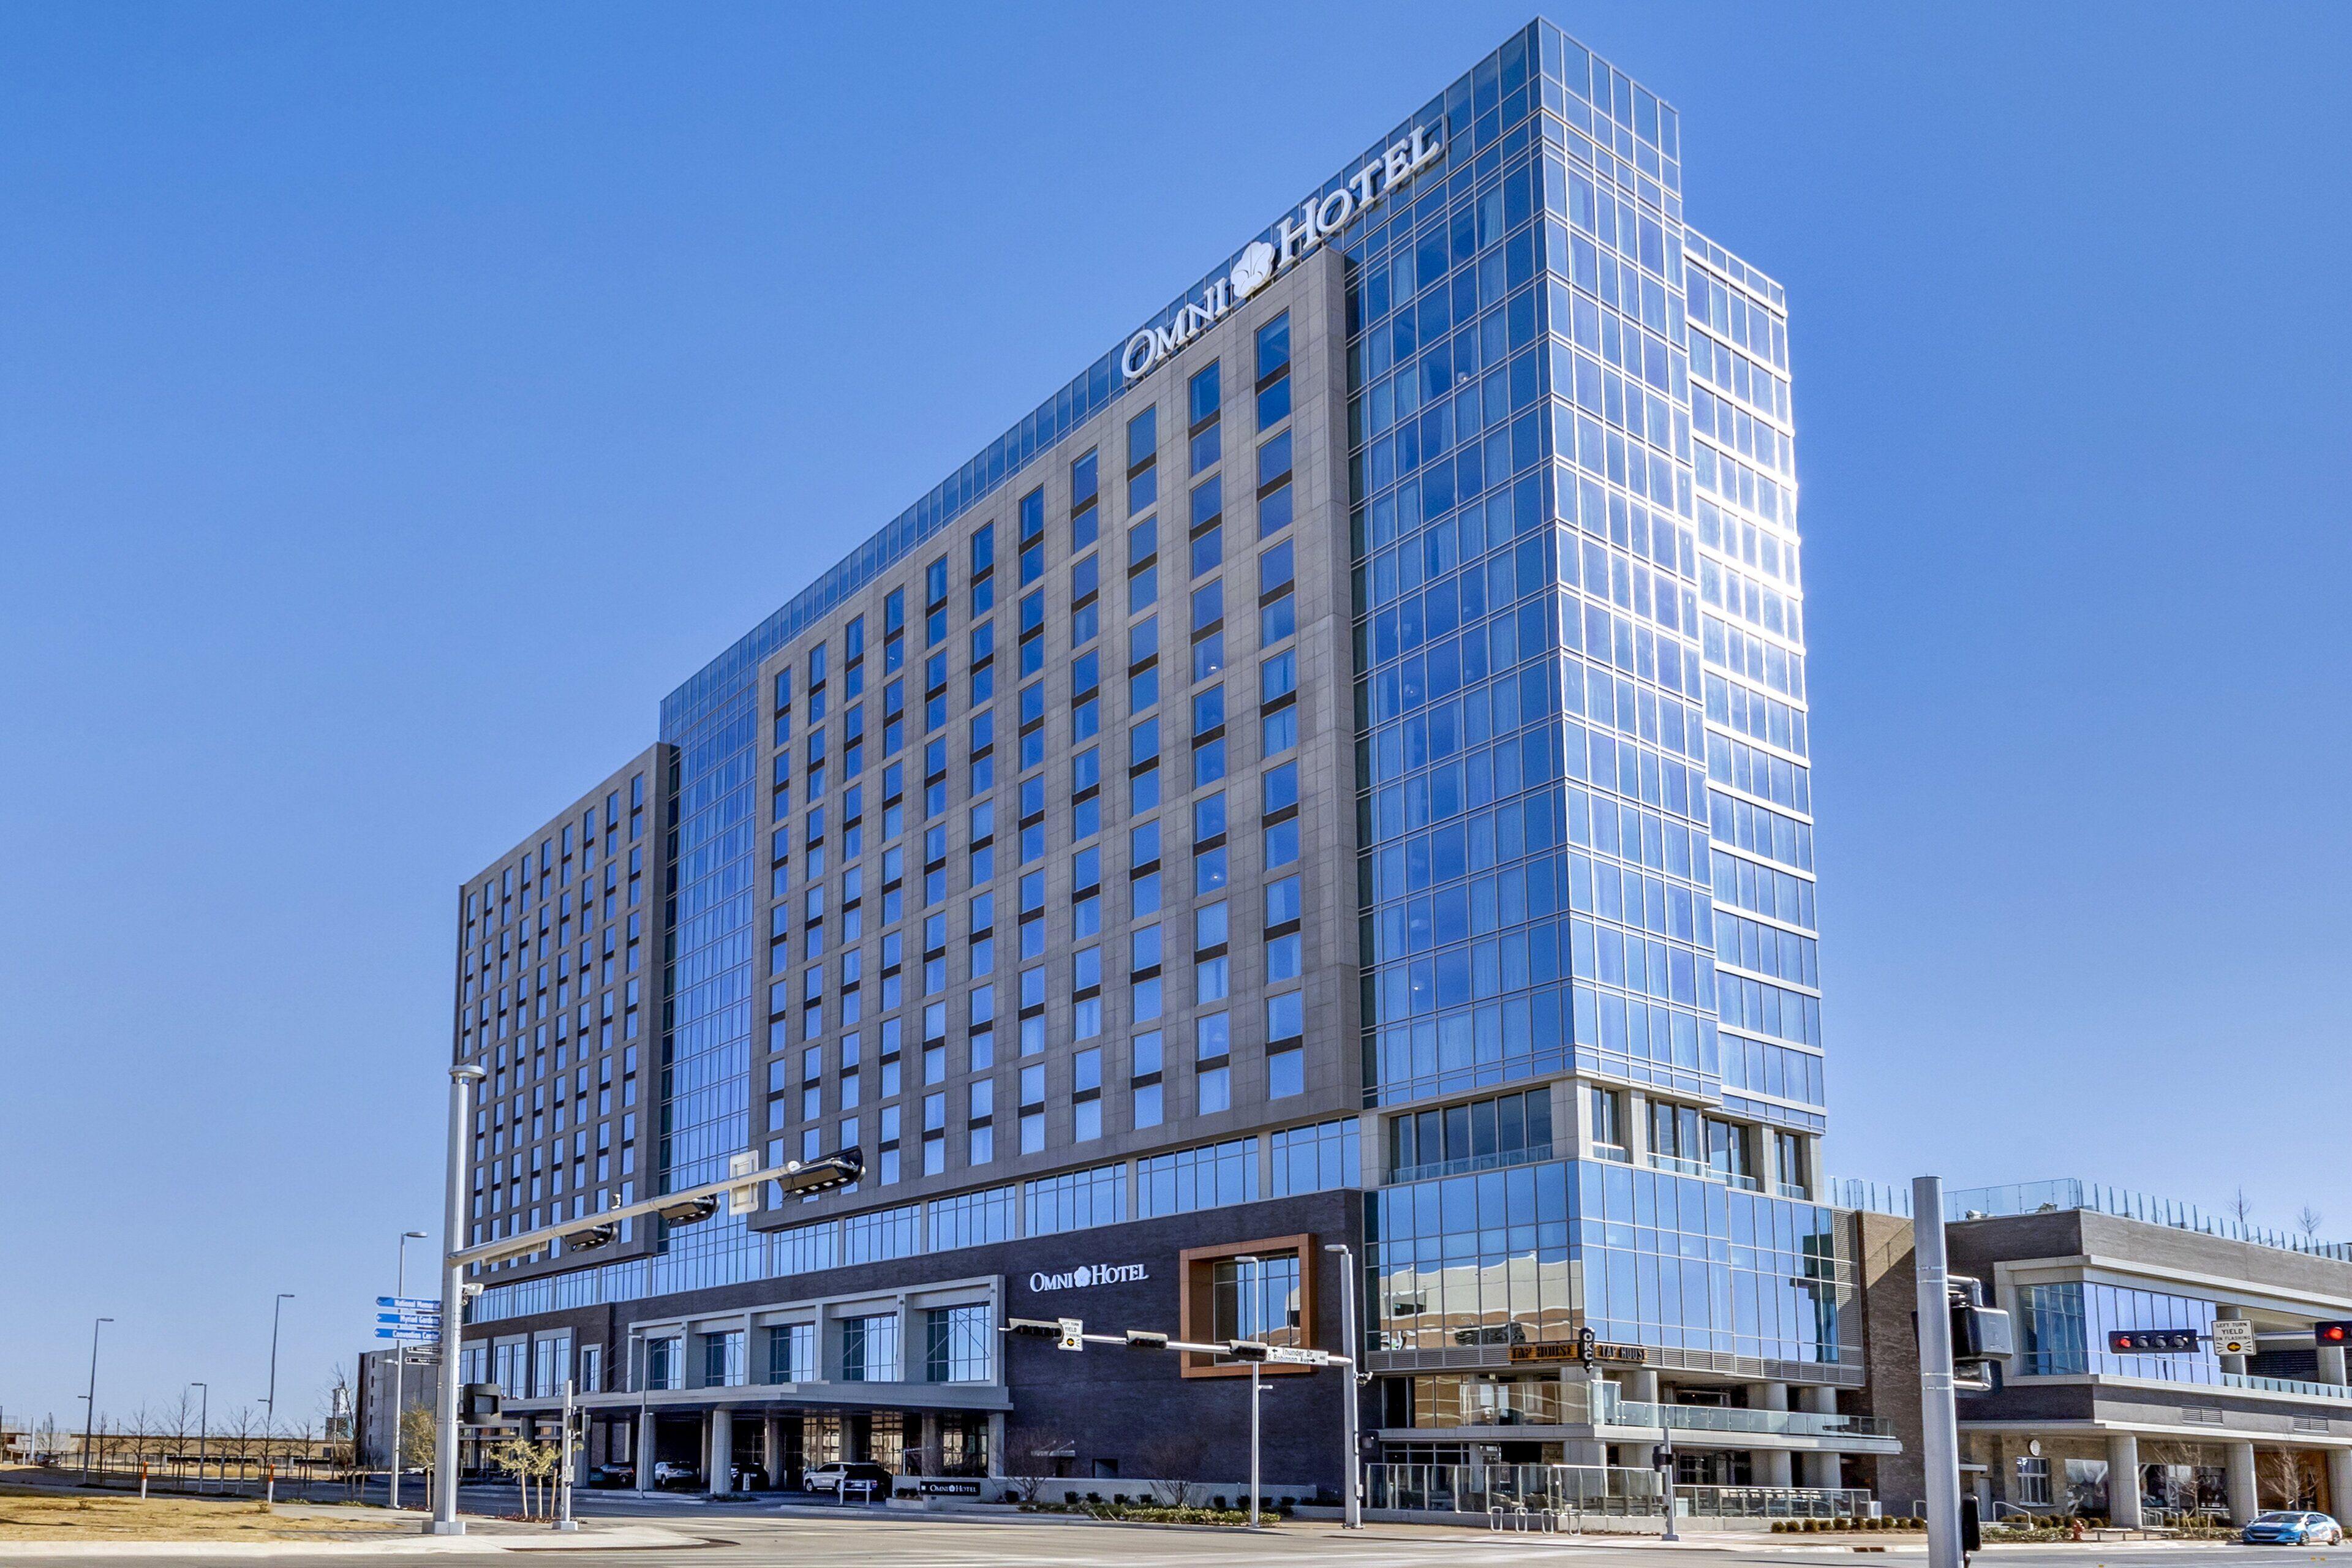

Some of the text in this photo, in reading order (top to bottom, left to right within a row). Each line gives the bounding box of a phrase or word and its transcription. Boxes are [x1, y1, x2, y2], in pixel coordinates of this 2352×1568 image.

[1121, 125, 1440, 379] OMNI HOTEL
[1030, 1264, 1150, 1292] OMNI HOTEL
[394, 1299, 416, 1308] National
[400, 1315, 418, 1324] Myriad
[393, 1330, 421, 1339] Convention
[1513, 1344, 1574, 1359] TAP HOUSE
[1583, 1332, 1593, 1360] OKC
[1601, 1344, 1617, 1357] TAP
[1273, 1354, 1298, 1362] Robinson
[1282, 1348, 1304, 1357] Thunder
